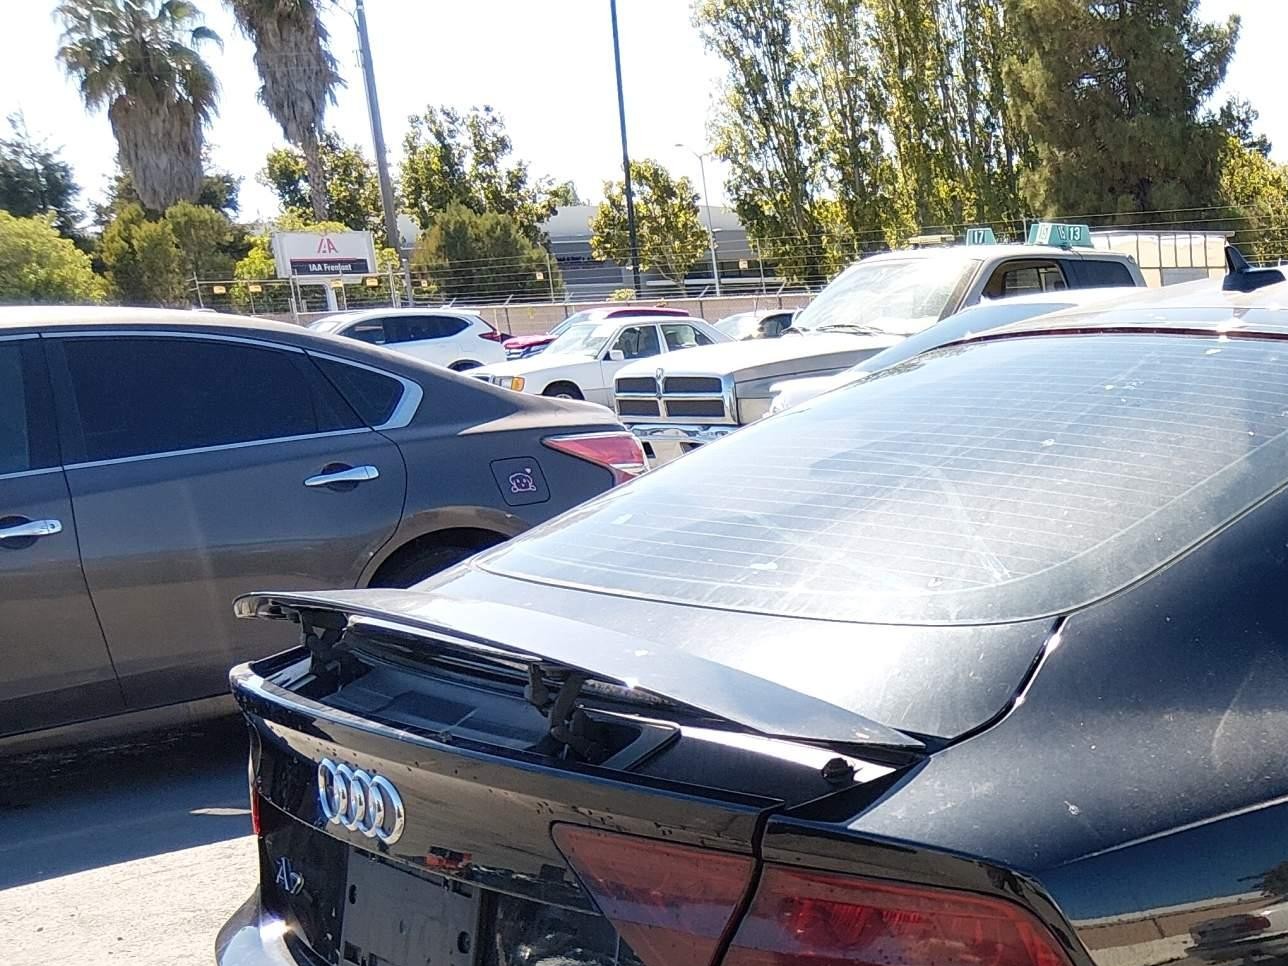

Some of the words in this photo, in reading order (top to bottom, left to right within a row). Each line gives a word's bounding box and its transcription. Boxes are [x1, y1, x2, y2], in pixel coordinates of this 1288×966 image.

[973, 231, 985, 244] 17
[1069, 226, 1081, 241] 13
[308, 263, 323, 272] IAA
